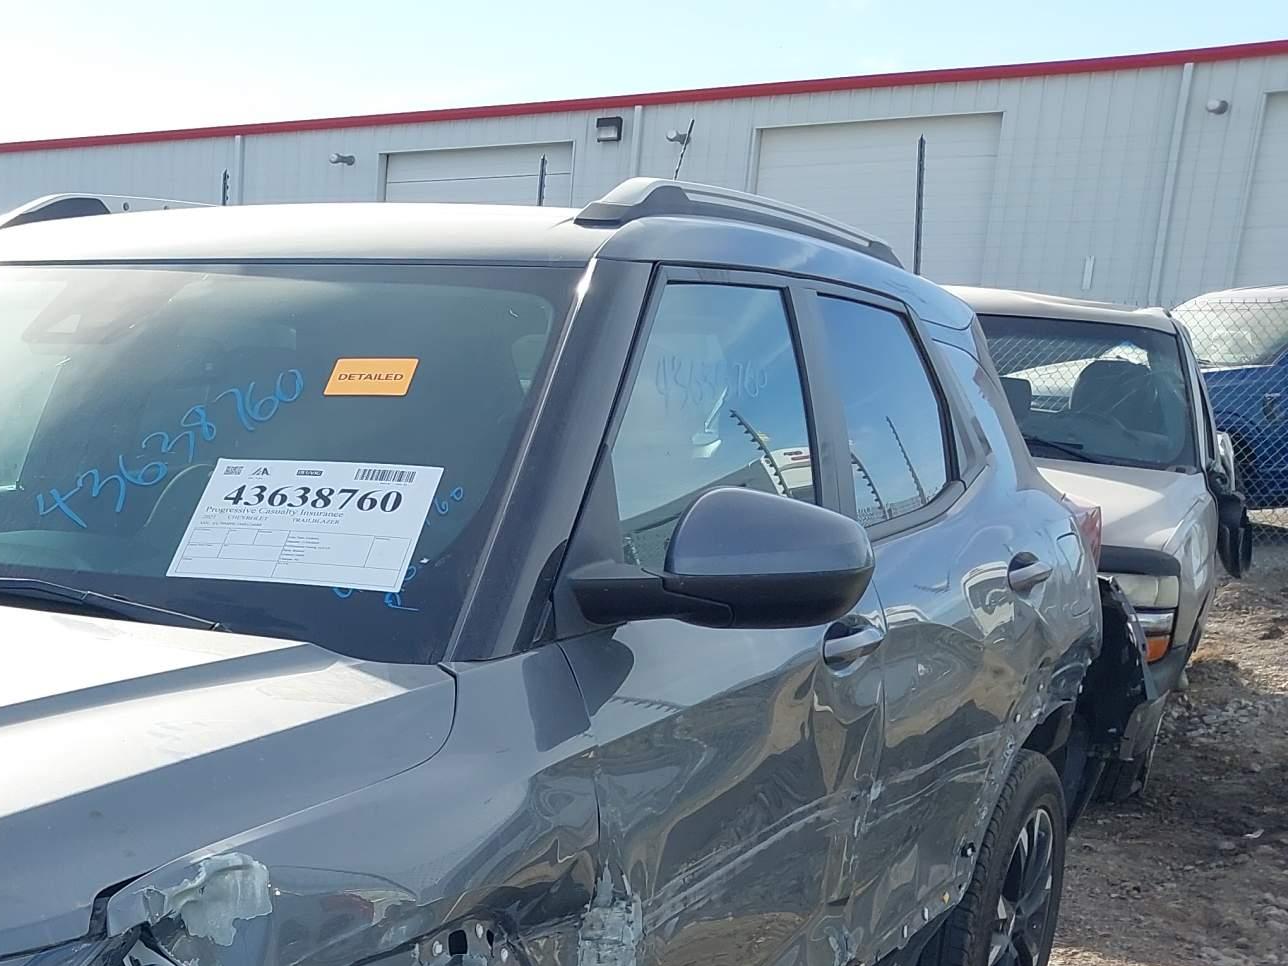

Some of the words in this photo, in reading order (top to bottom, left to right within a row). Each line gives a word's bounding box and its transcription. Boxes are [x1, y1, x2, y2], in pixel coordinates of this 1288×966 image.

[337, 372, 404, 382] DETAILED
[223, 484, 403, 513] 43638760
[206, 506, 256, 515] Progressive
[258, 507, 298, 516] Casualty
[300, 509, 344, 518] Insurance
